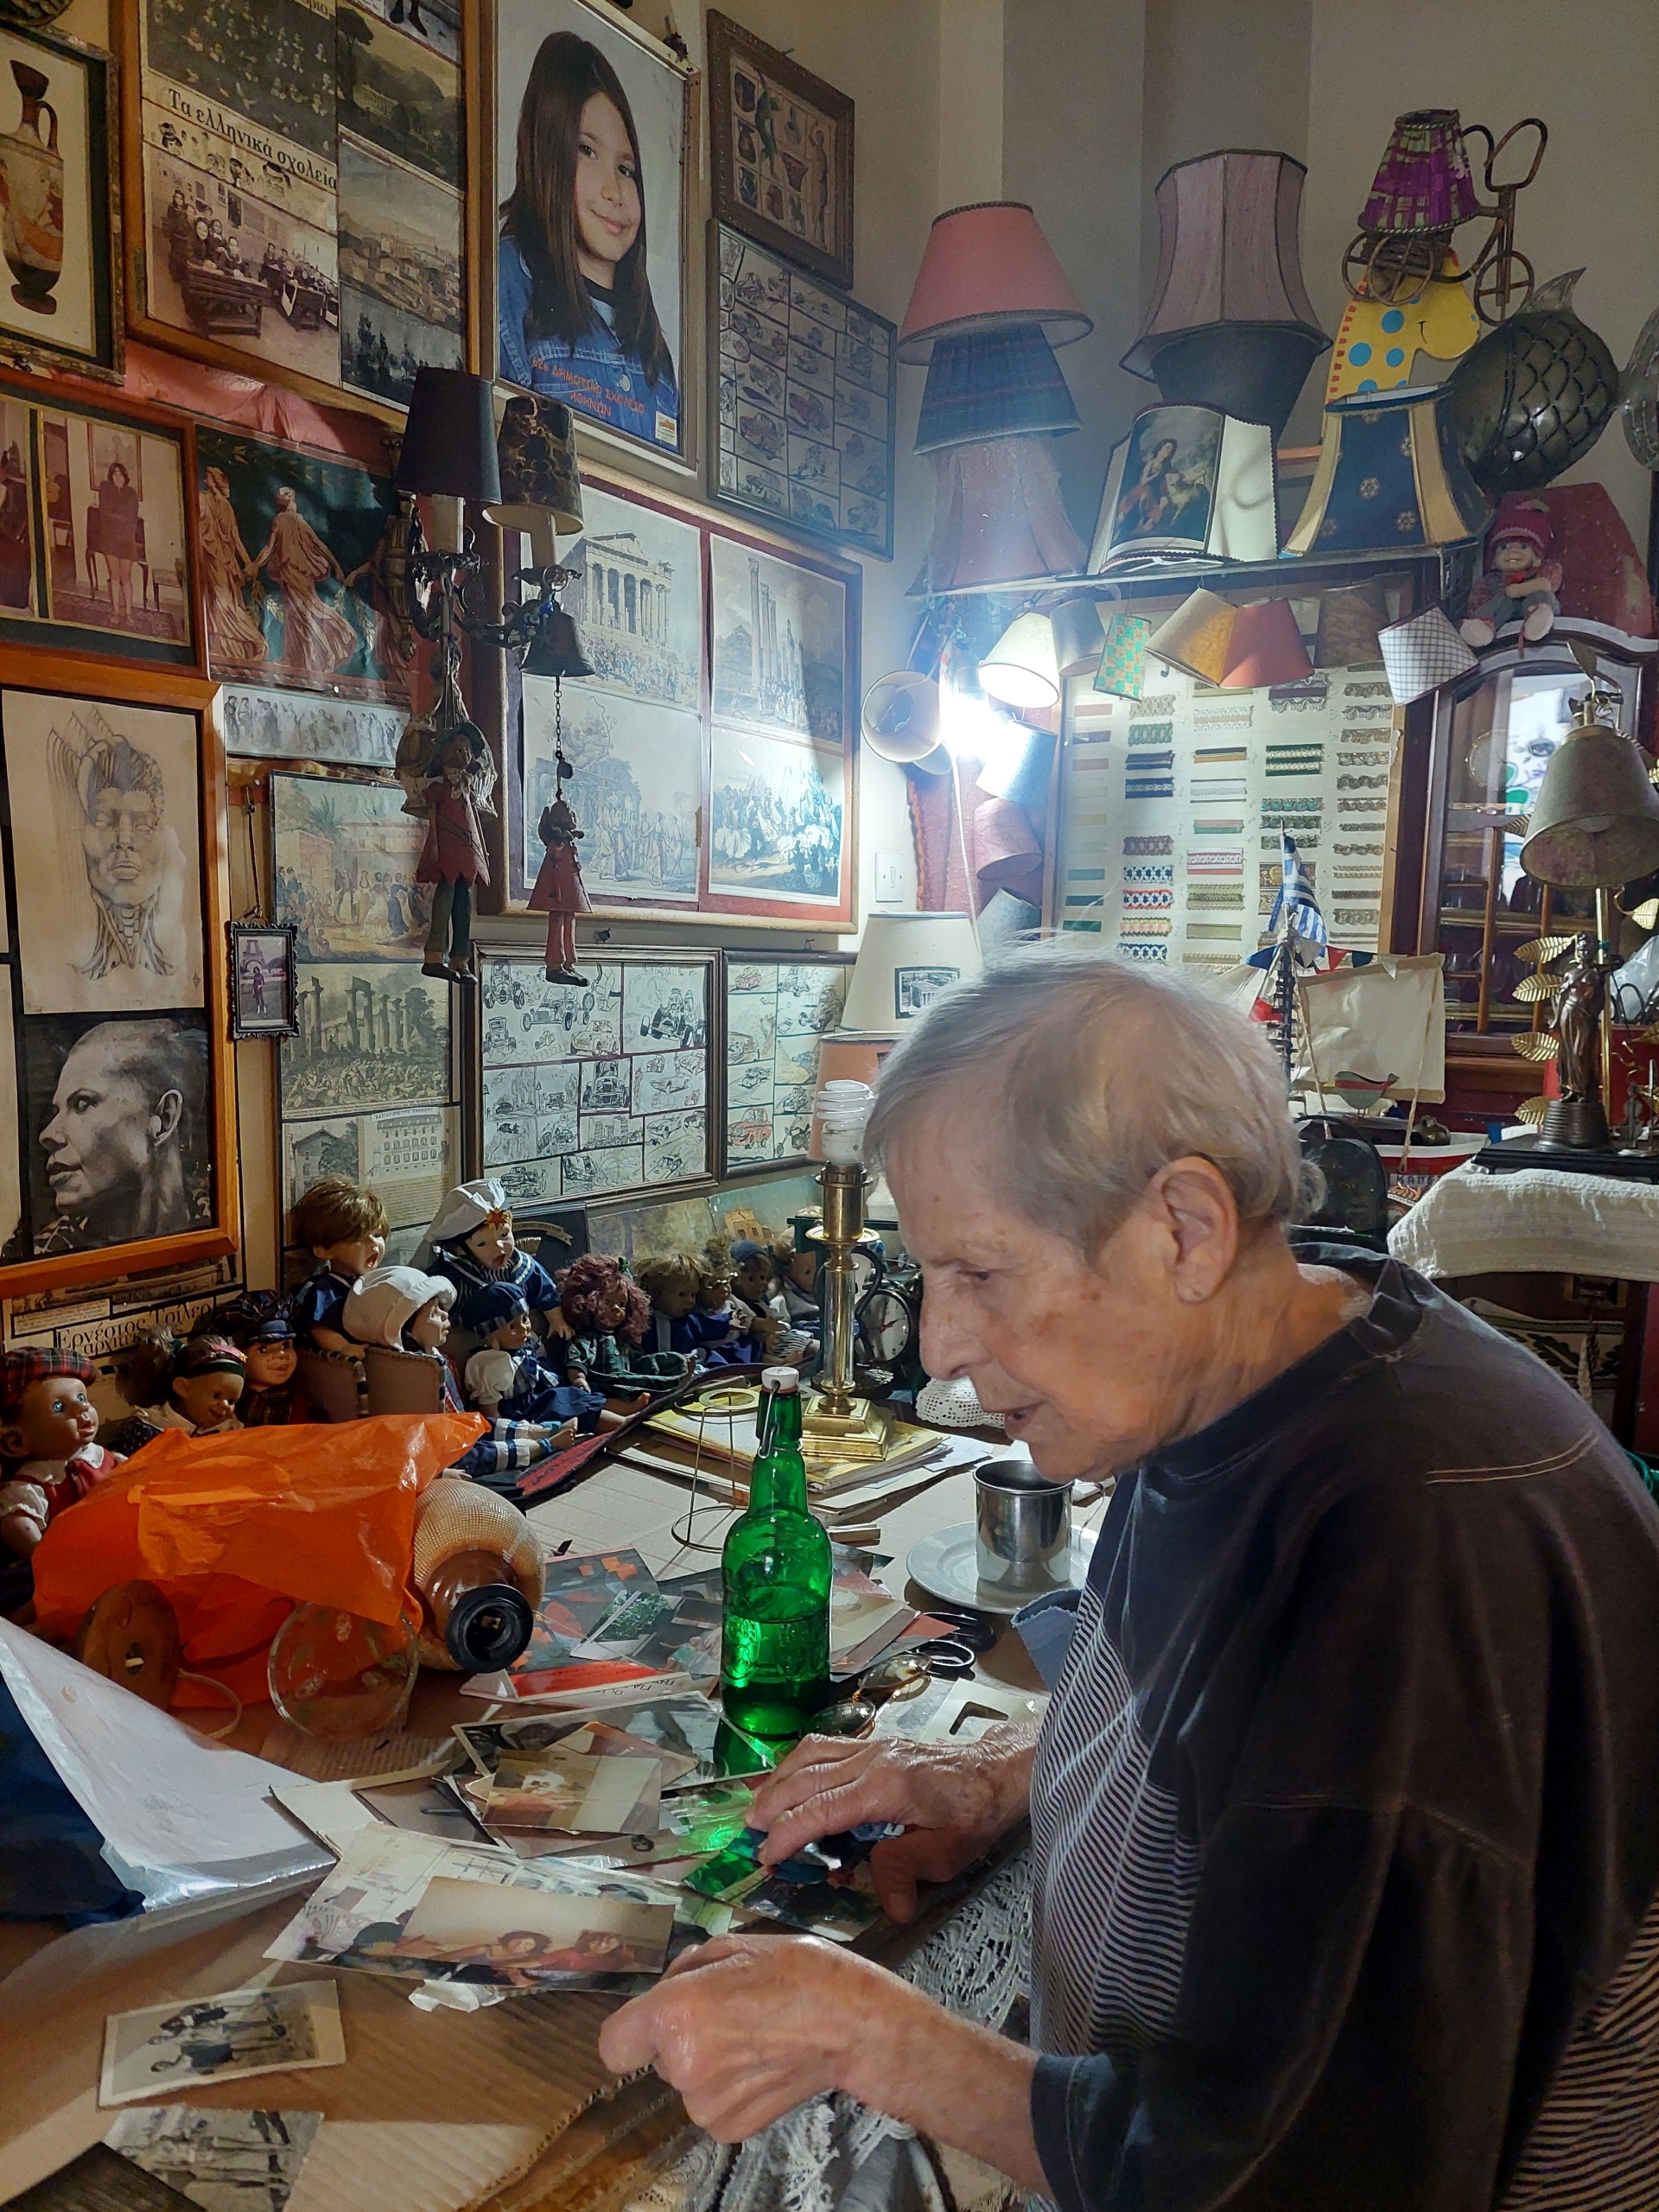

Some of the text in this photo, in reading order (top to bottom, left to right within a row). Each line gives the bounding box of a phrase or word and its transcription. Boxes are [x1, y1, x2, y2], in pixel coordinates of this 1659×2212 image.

[168, 88, 337, 190] Τα ελληνικά σχολεία
[569, 391, 612, 417] ΑΘΗΝΩΝ
[57, 1301, 213, 1349] Ερνέστος Τσίλερ
